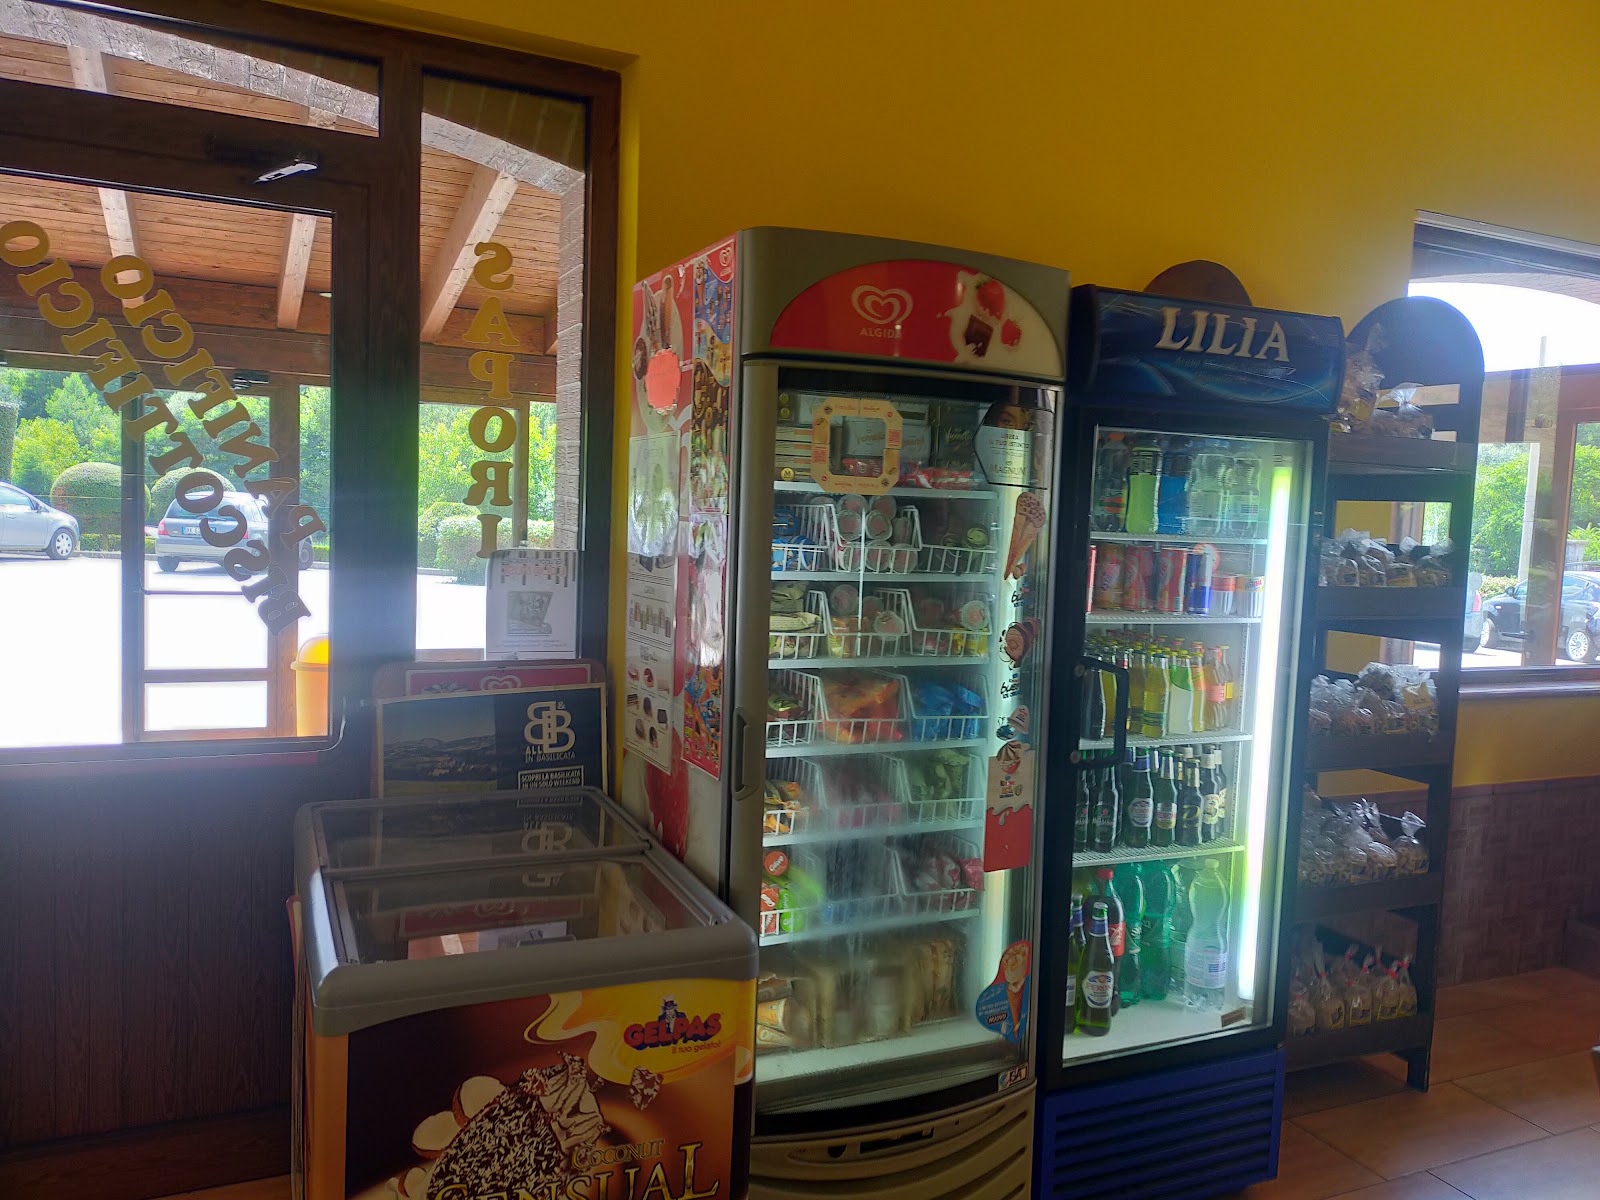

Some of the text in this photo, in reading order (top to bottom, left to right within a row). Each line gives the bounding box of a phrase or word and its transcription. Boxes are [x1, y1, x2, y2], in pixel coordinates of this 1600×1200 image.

[859, 326, 903, 340] ALGIDA
[1153, 305, 1291, 363] LILIA
[525, 745, 544, 755] ALL
[525, 751, 576, 764] IN BASILICATA
[623, 1011, 724, 1050] GELPAS
[433, 1142, 720, 1200] SUAL
